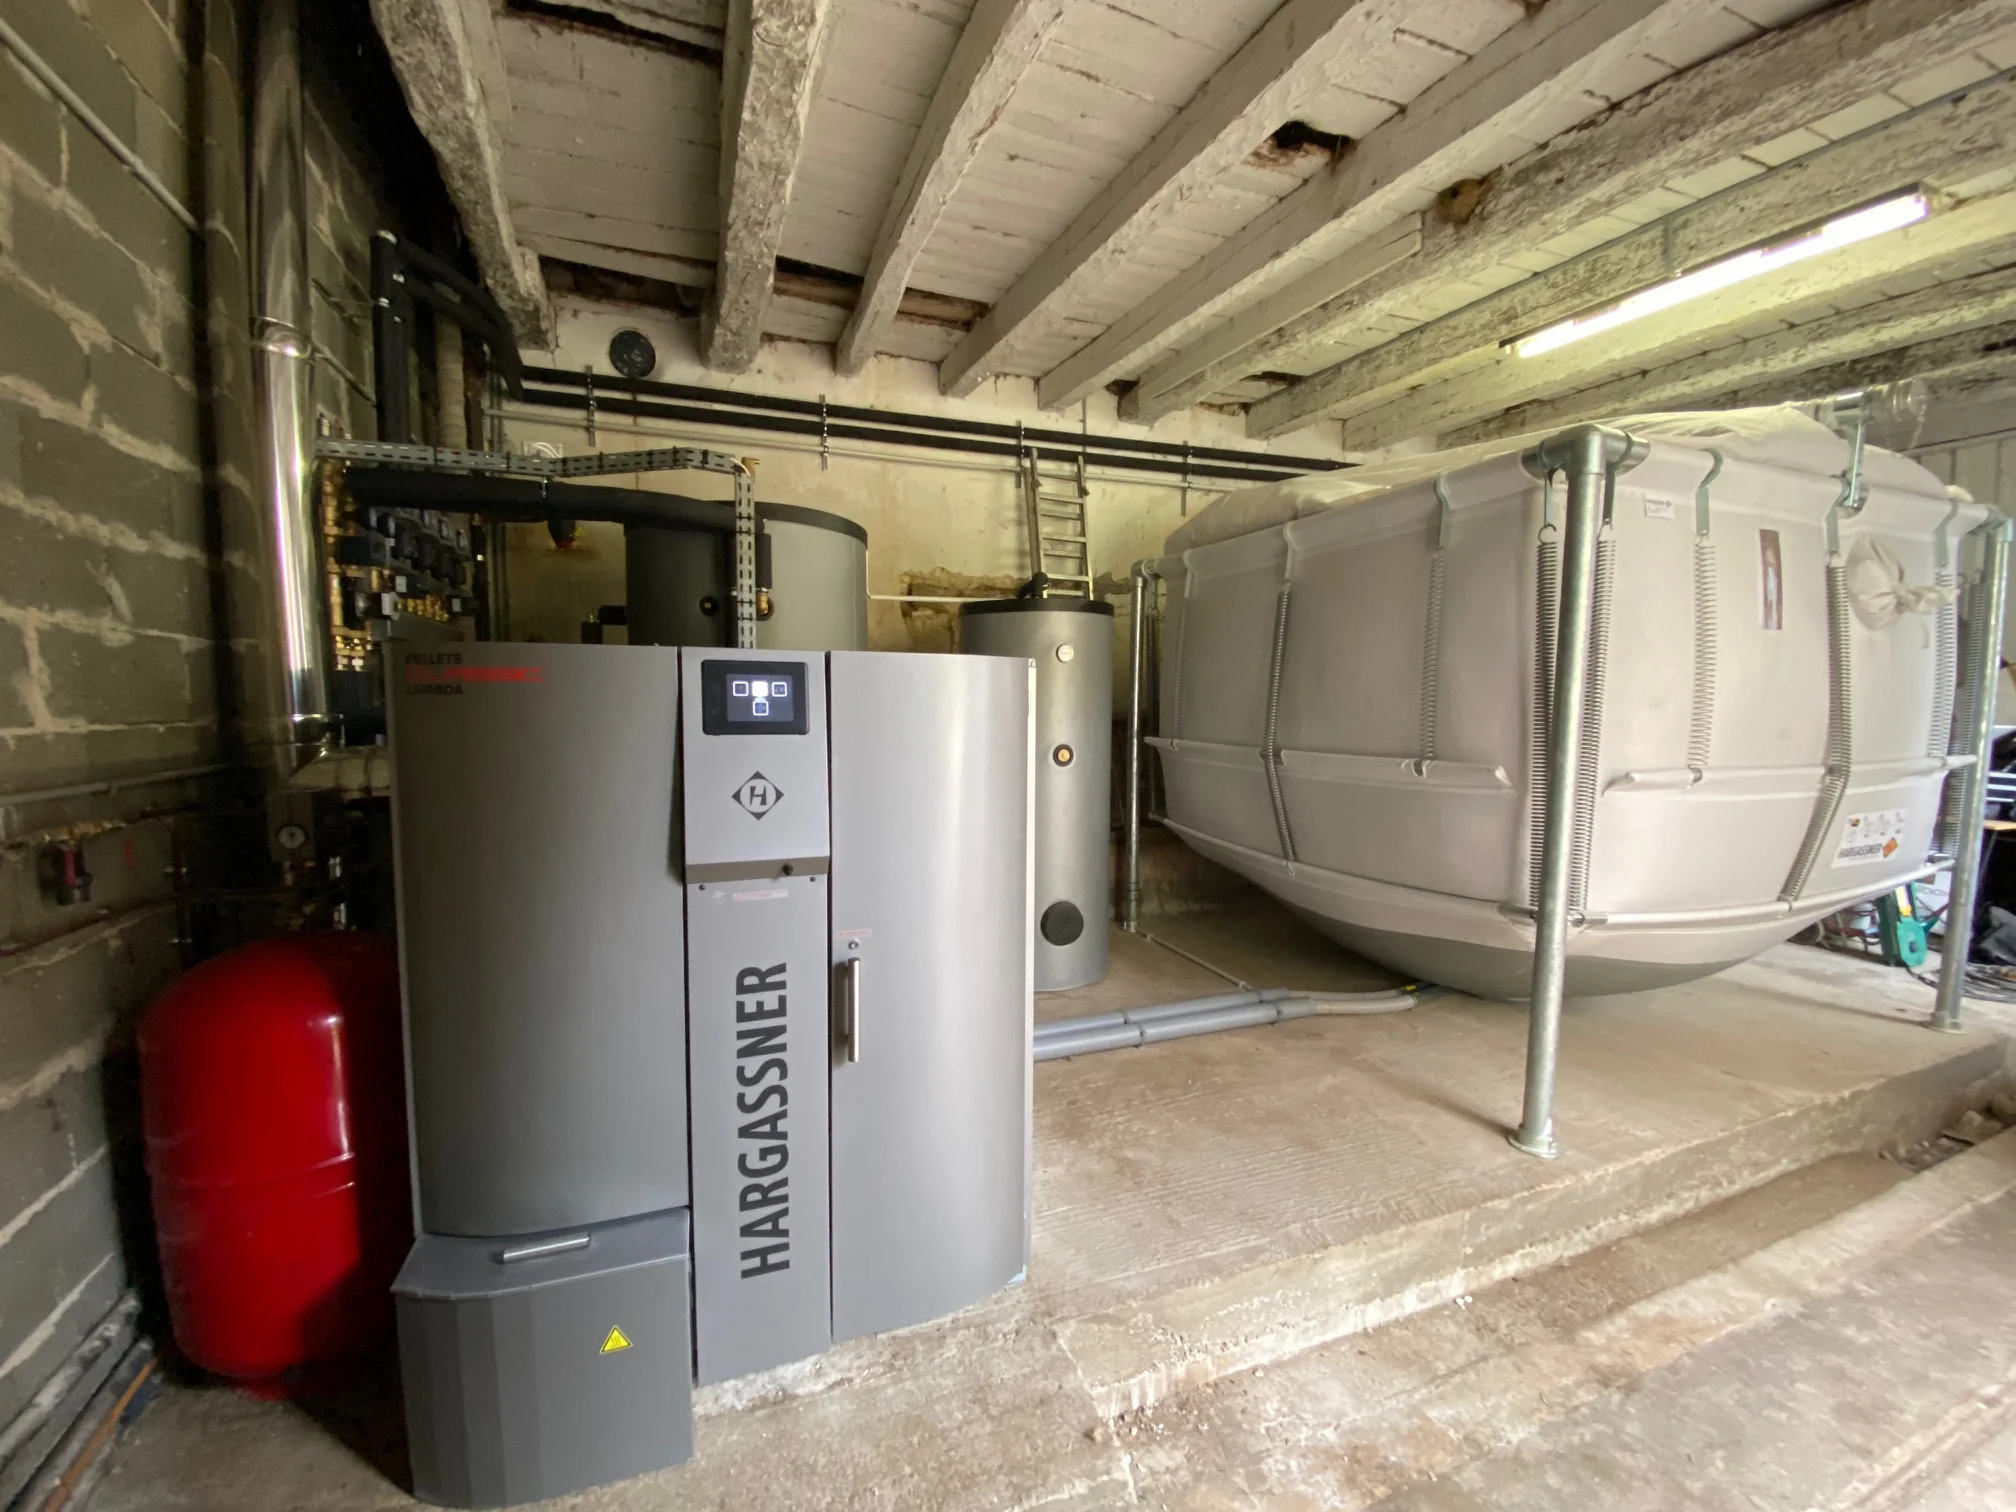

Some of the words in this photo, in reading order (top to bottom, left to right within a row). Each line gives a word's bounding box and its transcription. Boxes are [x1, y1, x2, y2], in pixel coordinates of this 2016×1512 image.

[405, 653, 462, 665] PELLETS
[405, 684, 464, 696] LAMBDA
[749, 784, 767, 806] H
[736, 962, 790, 1280] HARGASSNER
